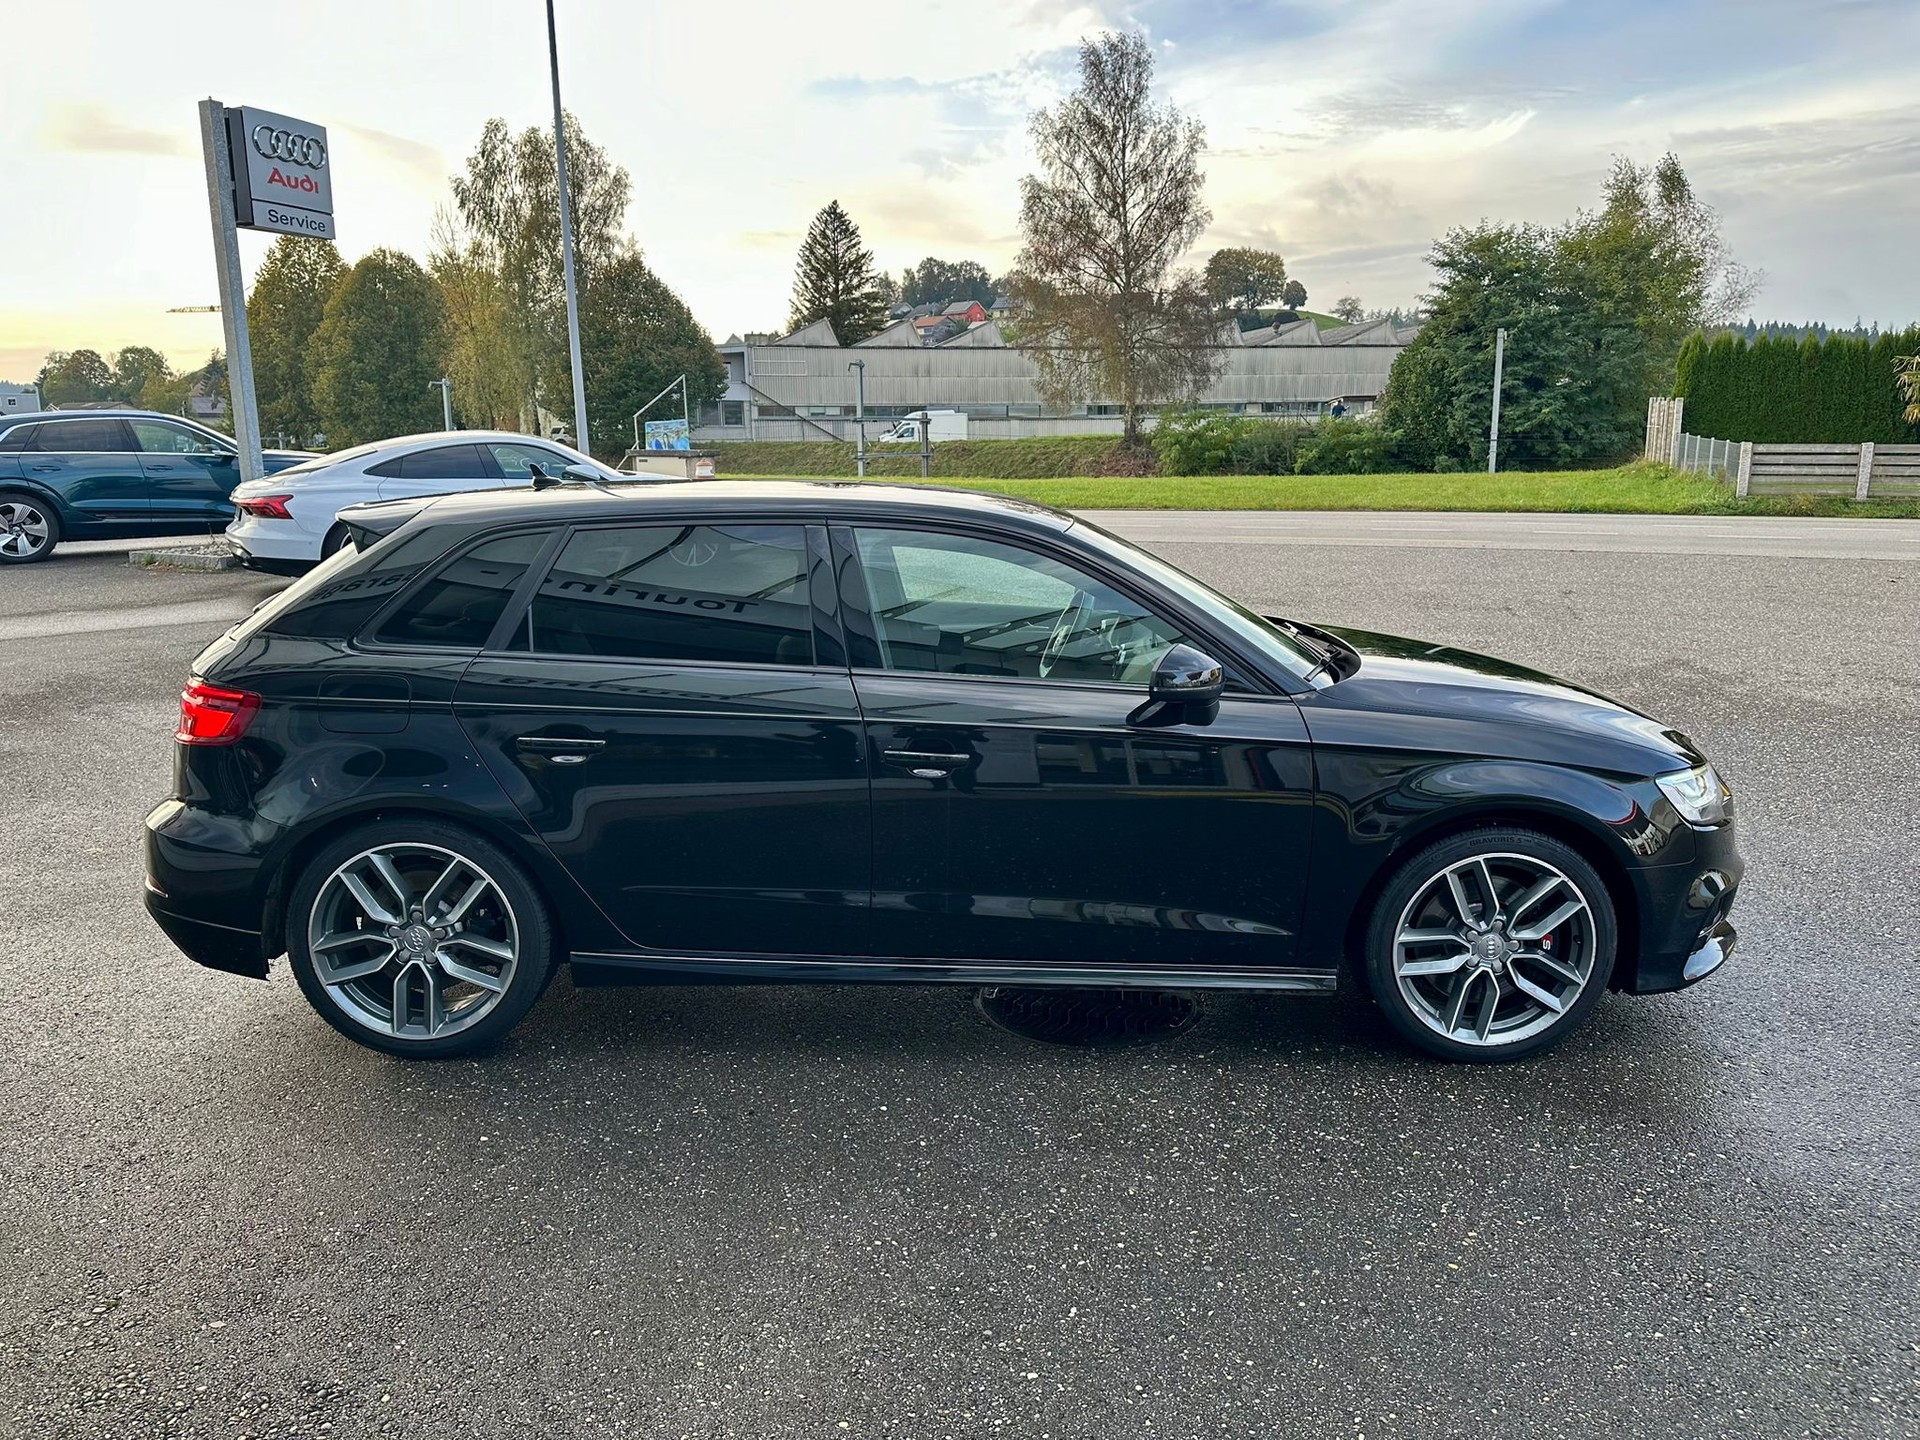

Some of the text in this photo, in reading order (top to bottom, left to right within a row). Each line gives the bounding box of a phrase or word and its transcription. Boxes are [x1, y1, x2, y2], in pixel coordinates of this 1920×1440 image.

[267, 167, 320, 194] Audi
[268, 209, 326, 232] Service
[1469, 836, 1516, 847] BRAVURIS
